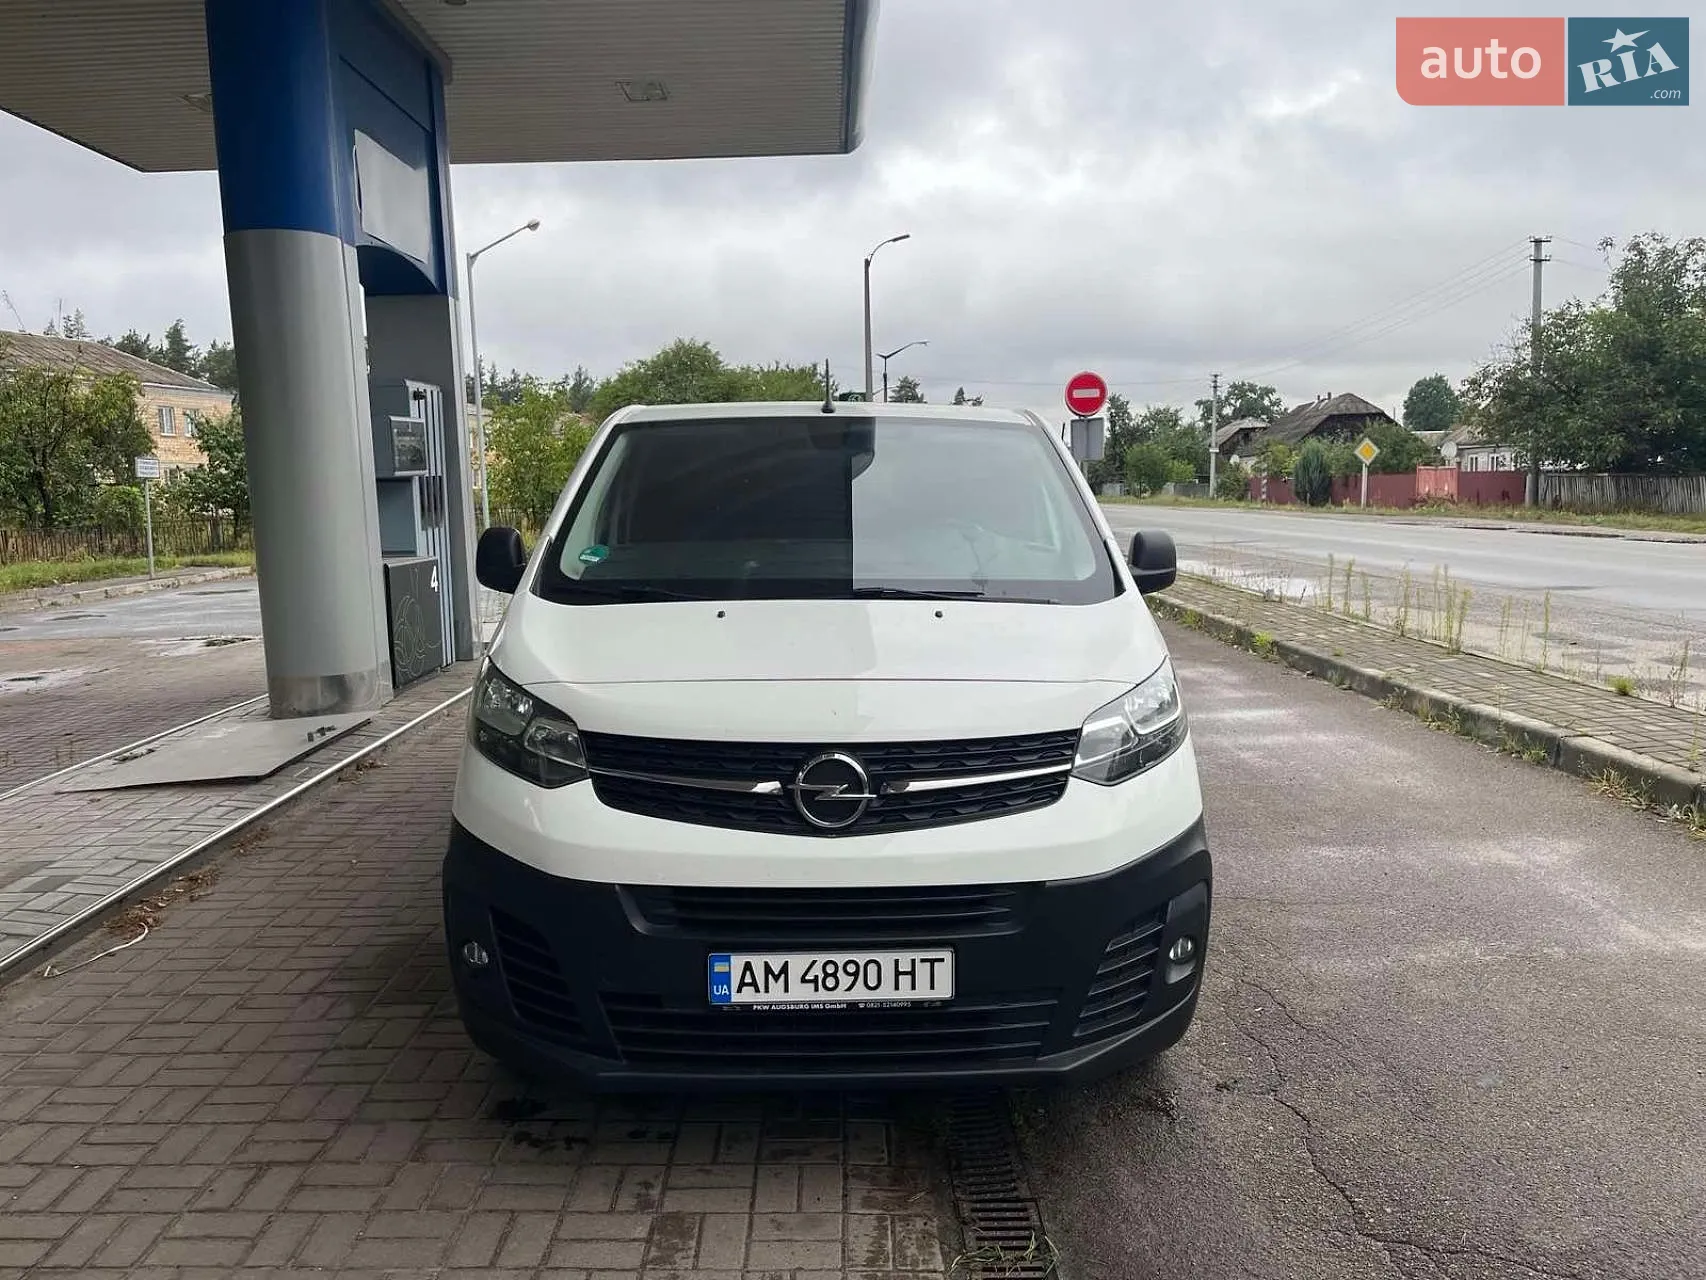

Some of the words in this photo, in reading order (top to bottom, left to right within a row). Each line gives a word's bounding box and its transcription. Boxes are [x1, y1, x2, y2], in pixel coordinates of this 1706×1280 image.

[430, 565, 439, 592] 4
[736, 960, 790, 994] AM
[800, 958, 883, 993] 4890
[894, 957, 946, 991] HT
[713, 985, 730, 996] UA
